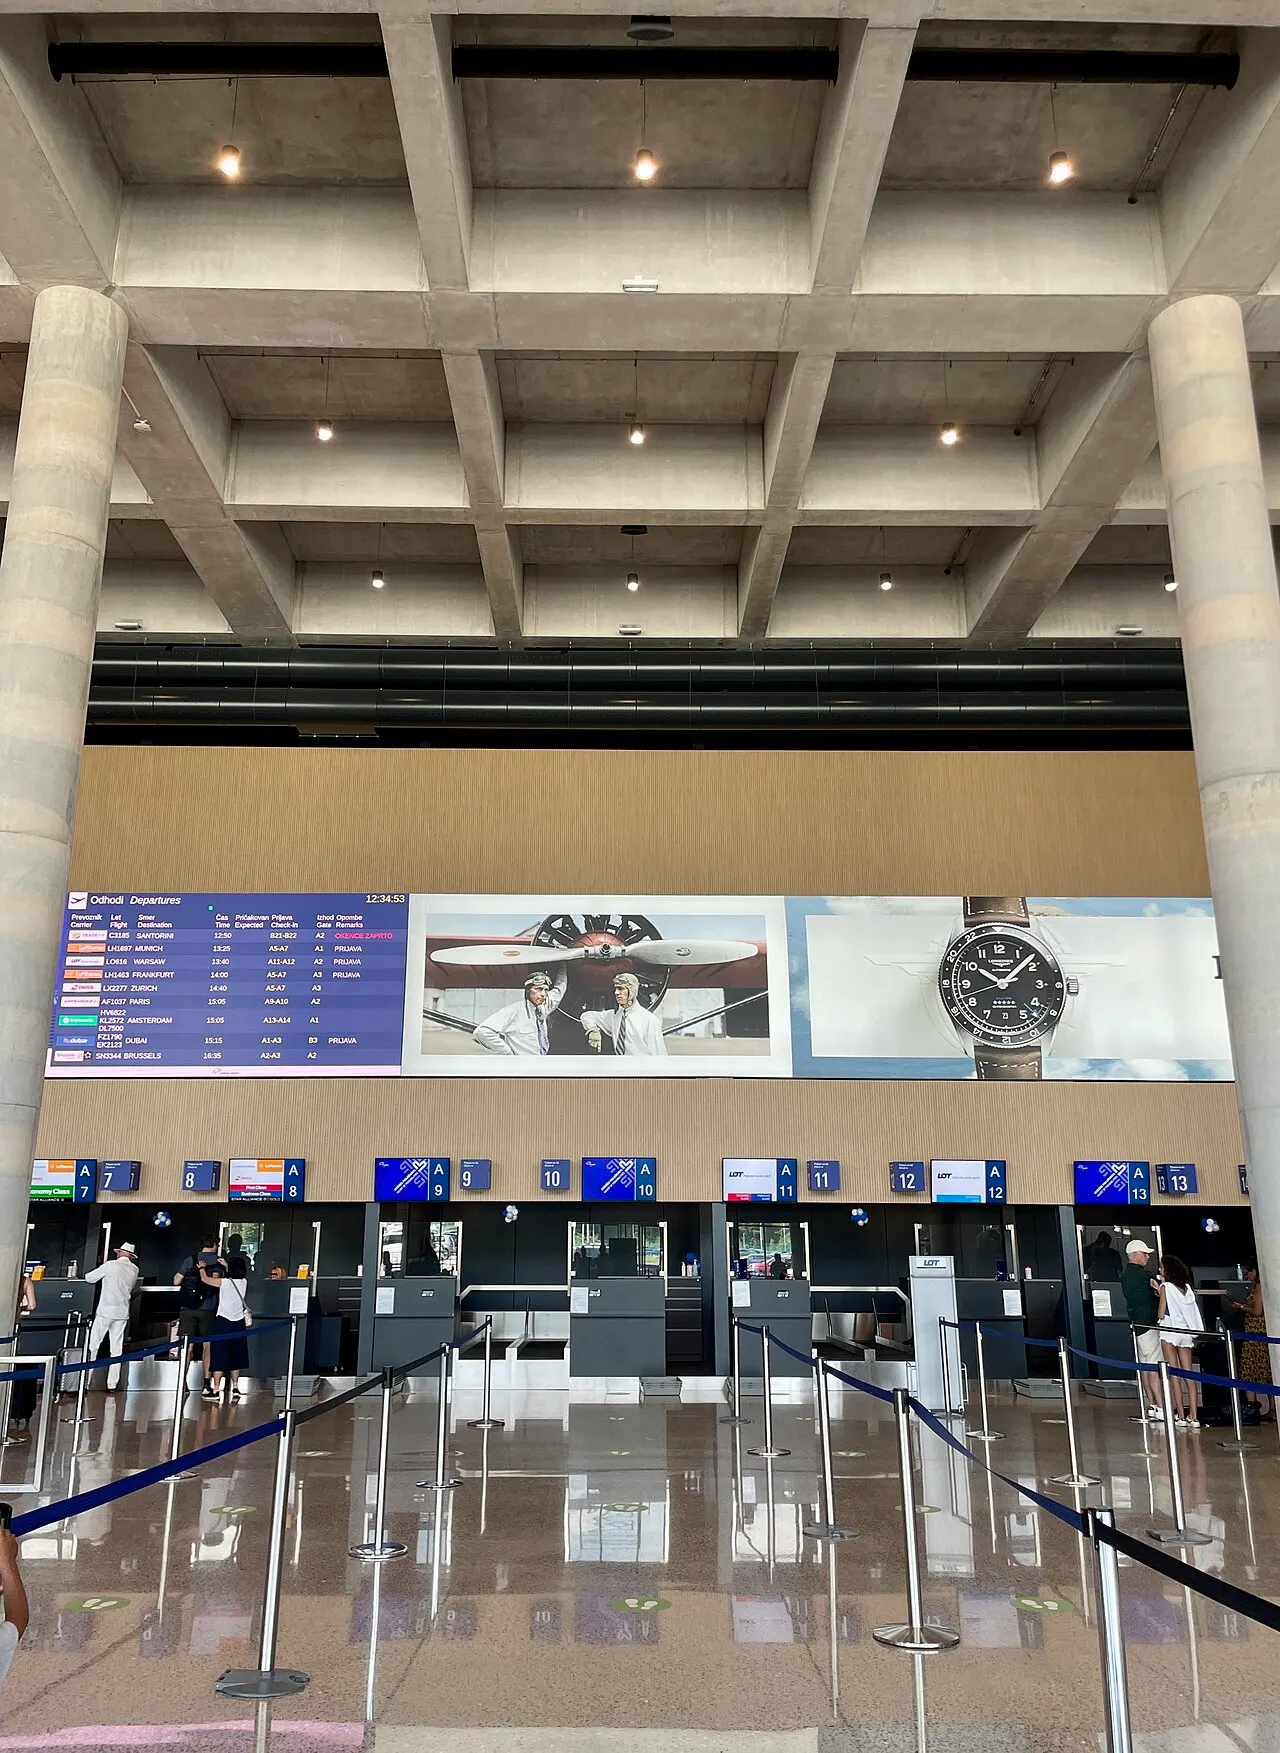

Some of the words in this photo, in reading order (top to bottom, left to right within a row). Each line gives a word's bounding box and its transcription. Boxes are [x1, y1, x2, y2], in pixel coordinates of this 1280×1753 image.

[90, 896, 124, 905] Odhodi
[129, 896, 181, 906] Departures
[366, 895, 405, 903] 12:34:53
[215, 913, 229, 921] Čas
[109, 921, 128, 929] Flight
[964, 932, 976, 942] 22
[978, 949, 986, 958] 11
[993, 945, 1005, 954] 12
[1015, 949, 1020, 959] 1
[947, 950, 958, 962] 20
[965, 962, 978, 971] 10
[1028, 962, 1037, 972] 2
[942, 980, 950, 988] 18
[962, 980, 971, 989] 9
[1035, 980, 1044, 989] 3
[968, 997, 977, 1006] 8
[1030, 997, 1040, 1006] 4
[983, 1010, 991, 1019] 7
[1019, 1010, 1028, 1019] 5
[1049, 1009, 1057, 1017] 8
[973, 1027, 983, 1037] 14
[1029, 1028, 1040, 1037] 10
[79, 1165, 91, 1177] A
[288, 1164, 299, 1176] A
[433, 1163, 444, 1175] A
[640, 1164, 650, 1175] A
[781, 1164, 791, 1176] A
[990, 1166, 1000, 1178] A
[1134, 1168, 1144, 1179] A
[104, 1173, 113, 1188] 7
[185, 1172, 195, 1188] 8
[462, 1171, 471, 1187] 9
[545, 1171, 560, 1186] 10
[814, 1172, 828, 1188] 11
[899, 1173, 916, 1189] 12
[1158, 1176, 1165, 1191] 13
[1171, 1175, 1188, 1191] 13
[80, 1186, 89, 1198] 7
[289, 1185, 297, 1197] 8
[434, 1184, 443, 1196] 9
[639, 1185, 653, 1196] 10
[779, 1185, 793, 1196] 11
[988, 1187, 1003, 1199] 12
[1132, 1189, 1147, 1200] 13
